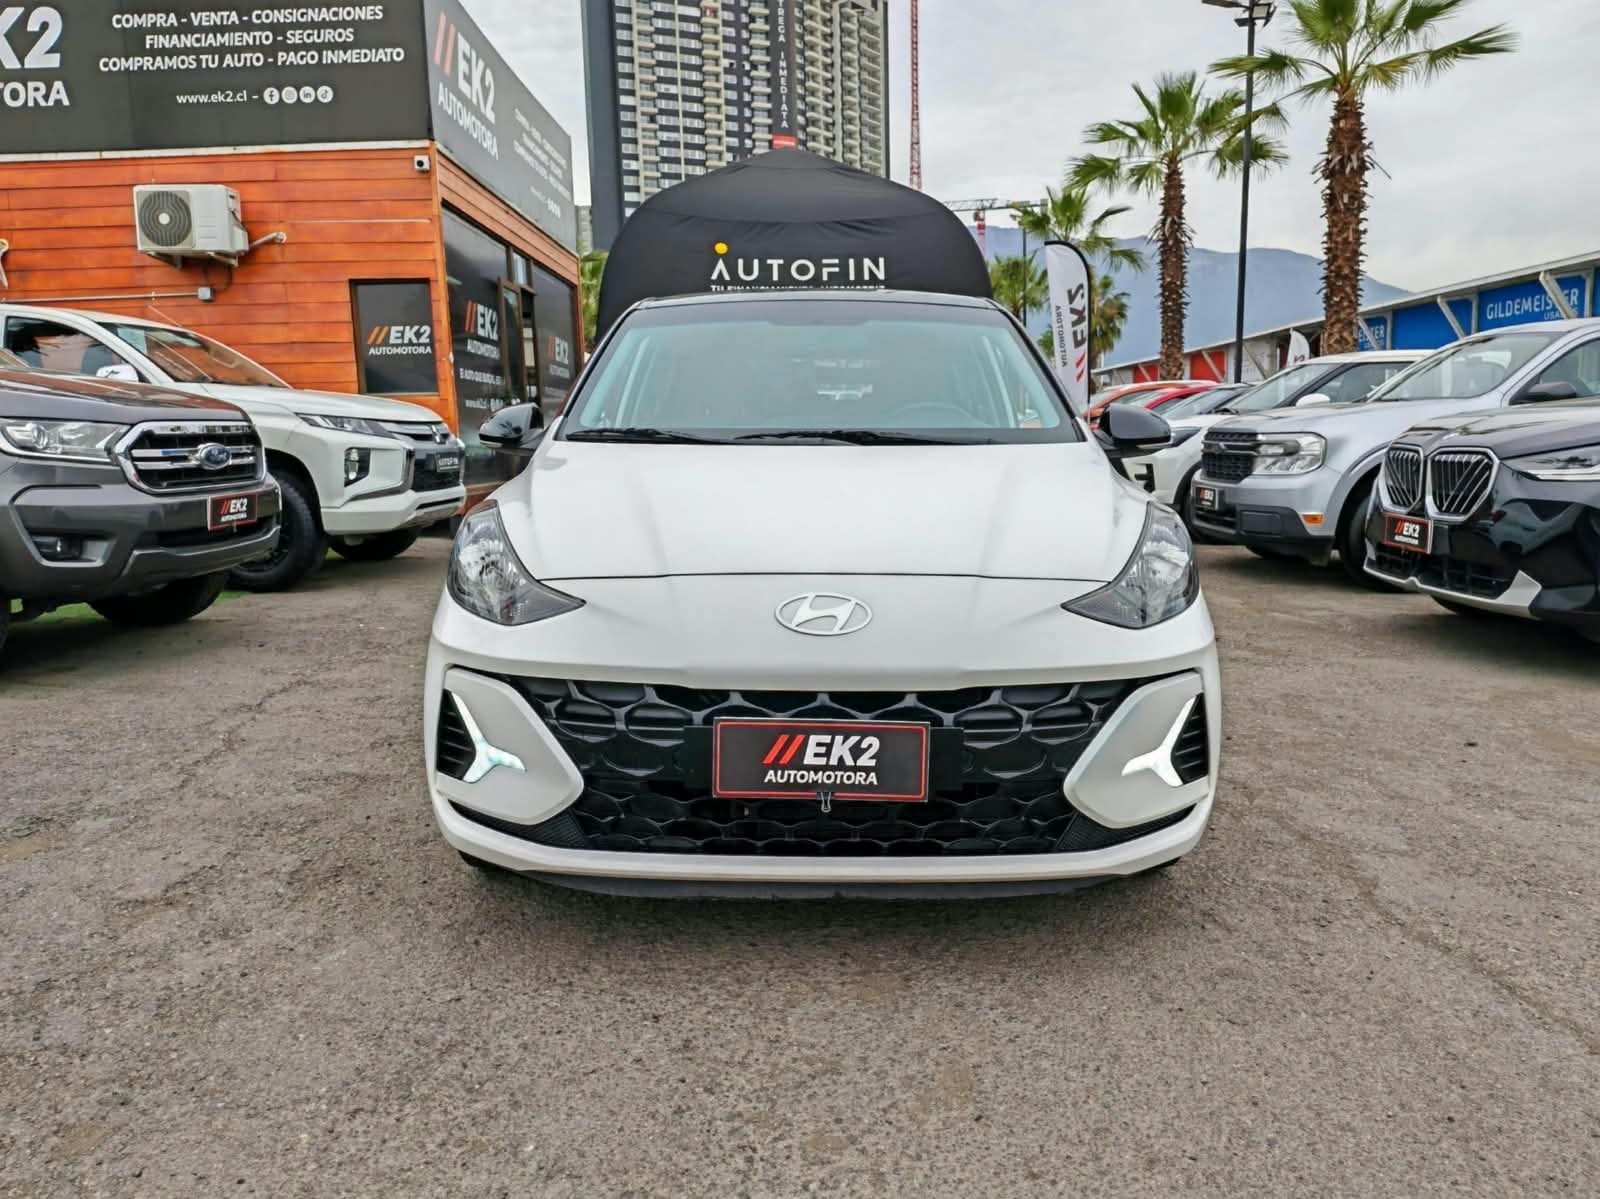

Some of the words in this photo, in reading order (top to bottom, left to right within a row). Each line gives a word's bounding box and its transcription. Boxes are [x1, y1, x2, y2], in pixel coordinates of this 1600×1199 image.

[111, 12, 178, 28] COMPRA
[190, 10, 239, 26] VENTA
[252, 5, 383, 24] CONSIGNACIONES
[145, 31, 273, 49] FINANCIAMIENTO
[286, 28, 354, 44] SEGUROS
[99, 55, 197, 72] COMPRAMOS
[199, 54, 219, 69] TU
[222, 52, 264, 68] AUTO
[277, 50, 319, 66] PAGO
[322, 48, 405, 64] INMEDIATO
[176, 90, 247, 104] www.ek2.cl
[779, 51, 789, 129] INMEDIATA
[438, 81, 499, 160] AUTOMOTORA
[710, 257, 886, 281] AUTOFIN
[368, 346, 432, 356] AUTOMOTORA
[763, 769, 879, 786] AUTOMOTORA
